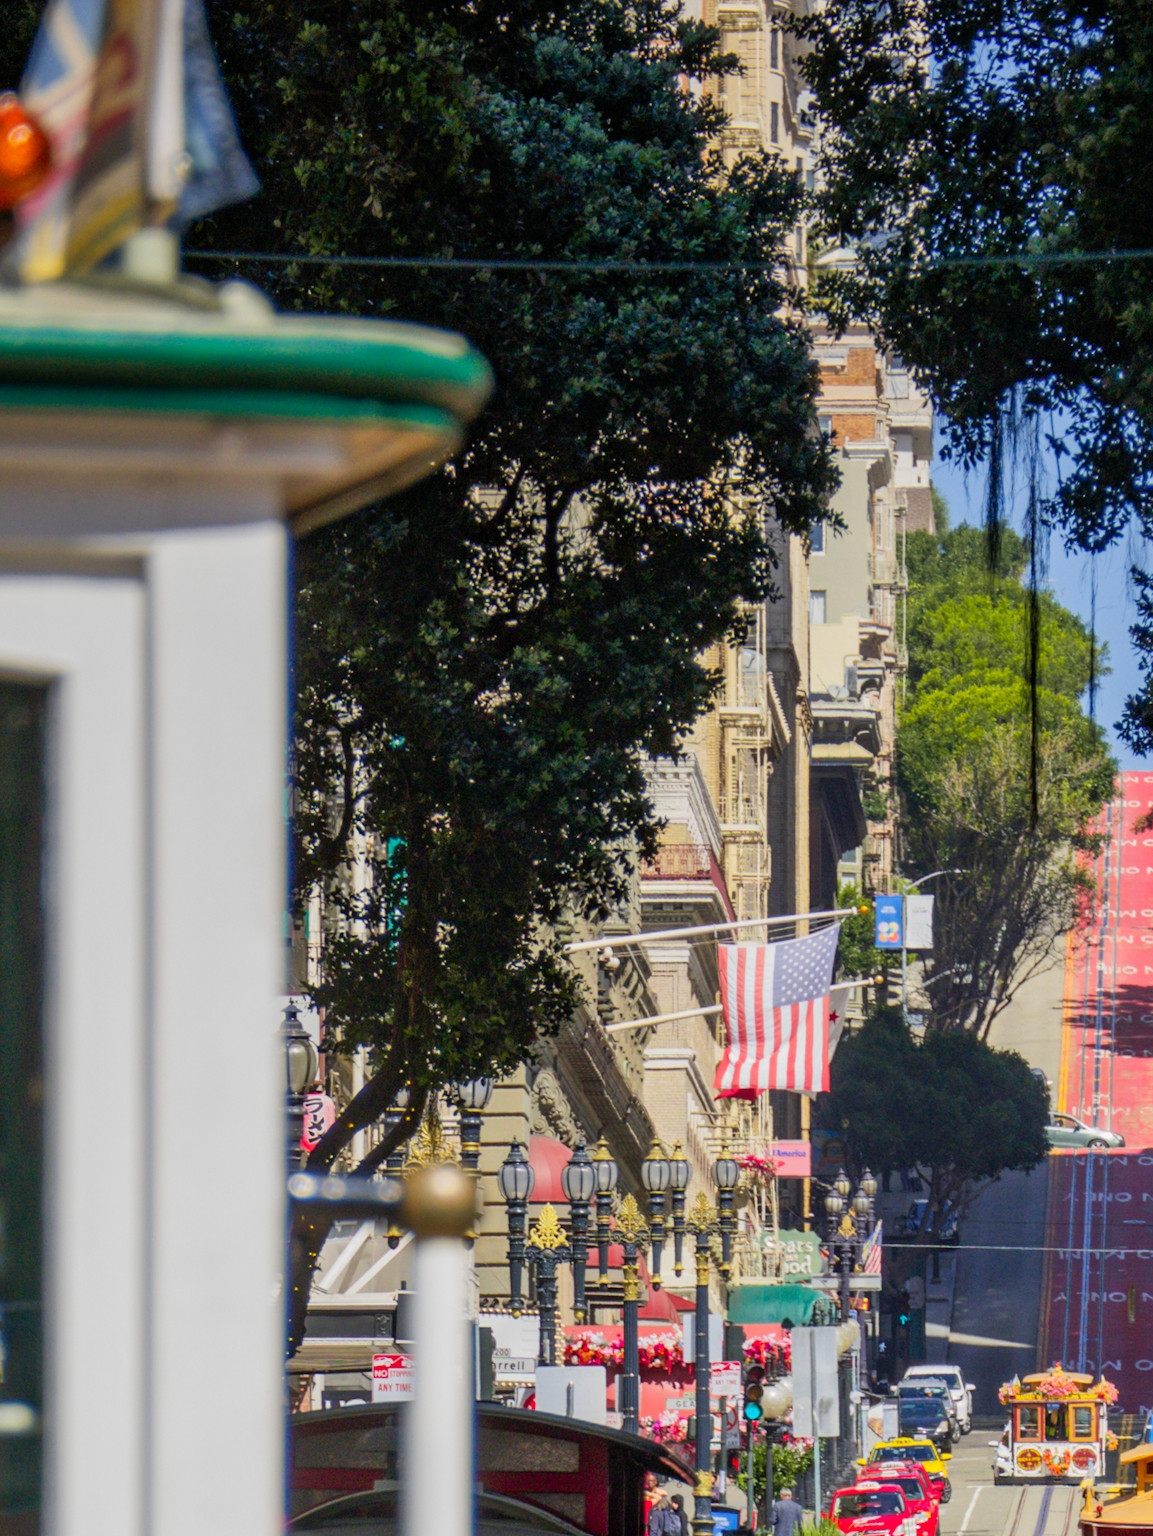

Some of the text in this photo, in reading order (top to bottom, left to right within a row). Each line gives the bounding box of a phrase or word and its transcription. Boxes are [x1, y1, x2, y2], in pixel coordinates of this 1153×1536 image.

[304, 1097, 324, 1143] ラーメン
[374, 1370, 387, 1378] NO
[378, 1384, 412, 1392] ANY TIME
